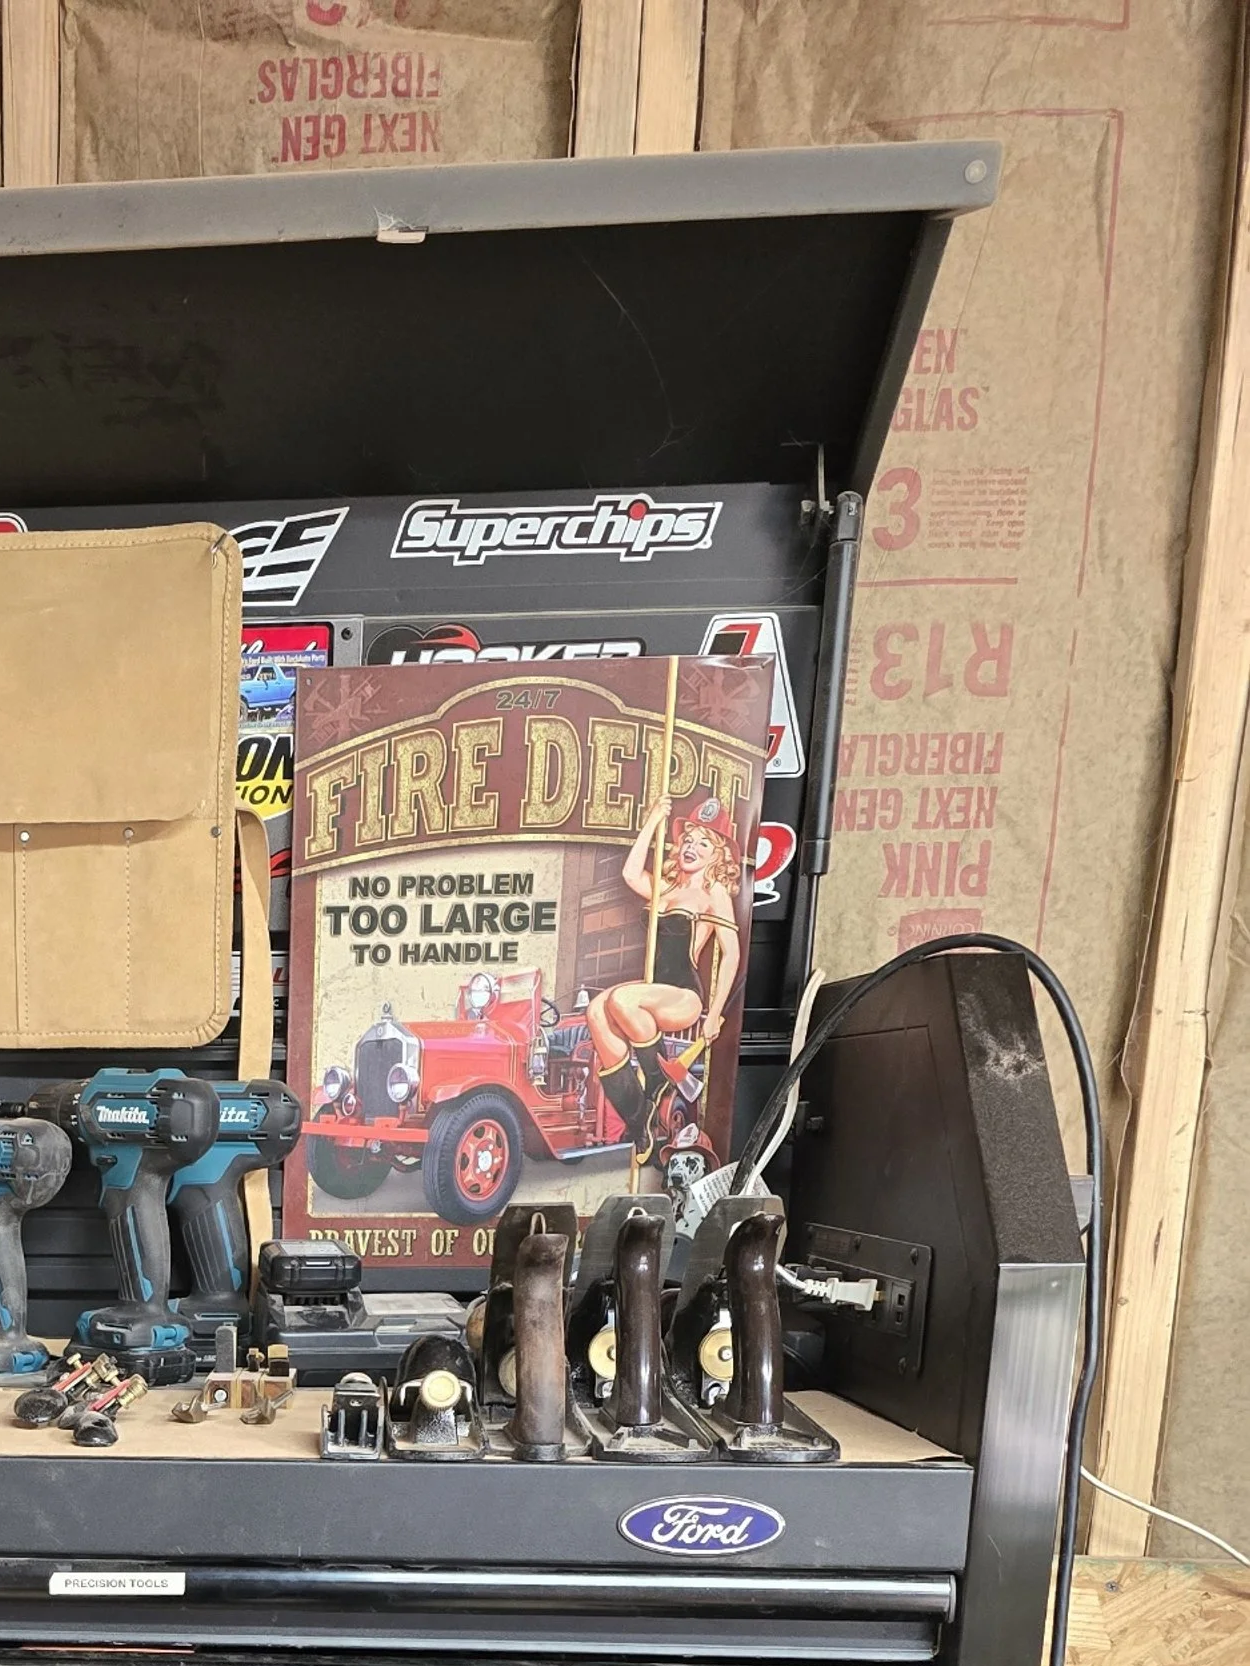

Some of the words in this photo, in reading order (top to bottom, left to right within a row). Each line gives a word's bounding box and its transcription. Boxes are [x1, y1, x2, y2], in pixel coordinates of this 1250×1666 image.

[258, 52, 443, 103] FIBERGLAS
[281, 114, 347, 163] GEN
[358, 111, 441, 155] NEXT
[401, 501, 707, 560] Superchips
[869, 620, 1015, 700] R13
[496, 689, 561, 710] 24/7
[303, 715, 503, 860] FIRE
[912, 786, 999, 830] NEXT
[350, 875, 391, 899] NO
[400, 873, 535, 898] PROBLEM
[877, 840, 993, 899] PINK
[324, 904, 409, 938] TOO
[419, 901, 558, 936] LARGE
[351, 943, 393, 967] TO
[404, 941, 519, 966] HANDLE
[97, 1105, 150, 1124] Makita
[431, 1229, 459, 1257] OF
[651, 1504, 754, 1546] Ford
[64, 1578, 127, 1588] PRECISION
[131, 1578, 169, 1588] TOOLS
